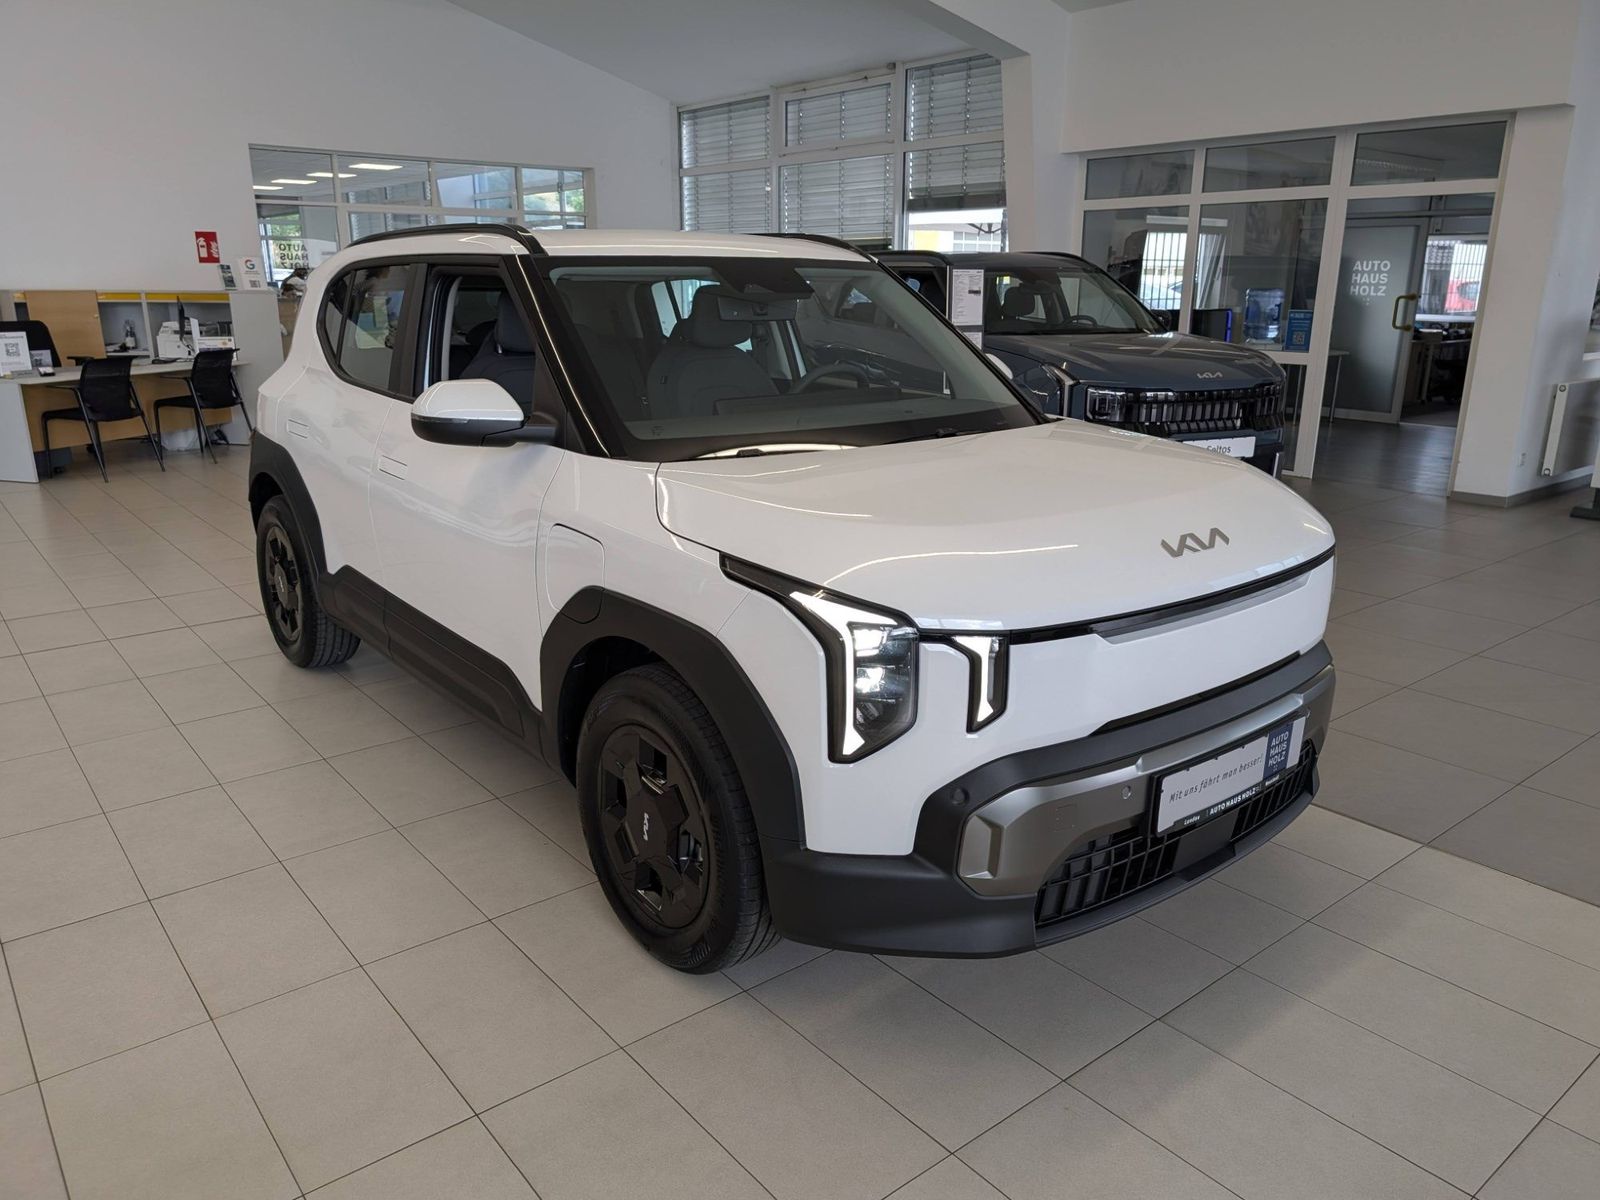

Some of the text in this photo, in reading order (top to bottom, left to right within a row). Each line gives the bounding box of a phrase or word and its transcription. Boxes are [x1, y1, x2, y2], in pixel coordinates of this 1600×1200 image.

[1352, 260, 1391, 271] AUTO
[1351, 273, 1388, 284] HAUS
[1350, 285, 1387, 296] HOLZ
[1160, 527, 1230, 558] KIA
[1271, 731, 1289, 748] AUTO
[1270, 741, 1287, 757] HAUS
[1268, 751, 1287, 767] HOLZ
[1169, 790, 1183, 804] Mit
[1184, 785, 1198, 797] uns
[1199, 774, 1221, 793] fährt
[1221, 768, 1238, 781] man
[1210, 787, 1256, 815] AUTO HAUS HOLZ
